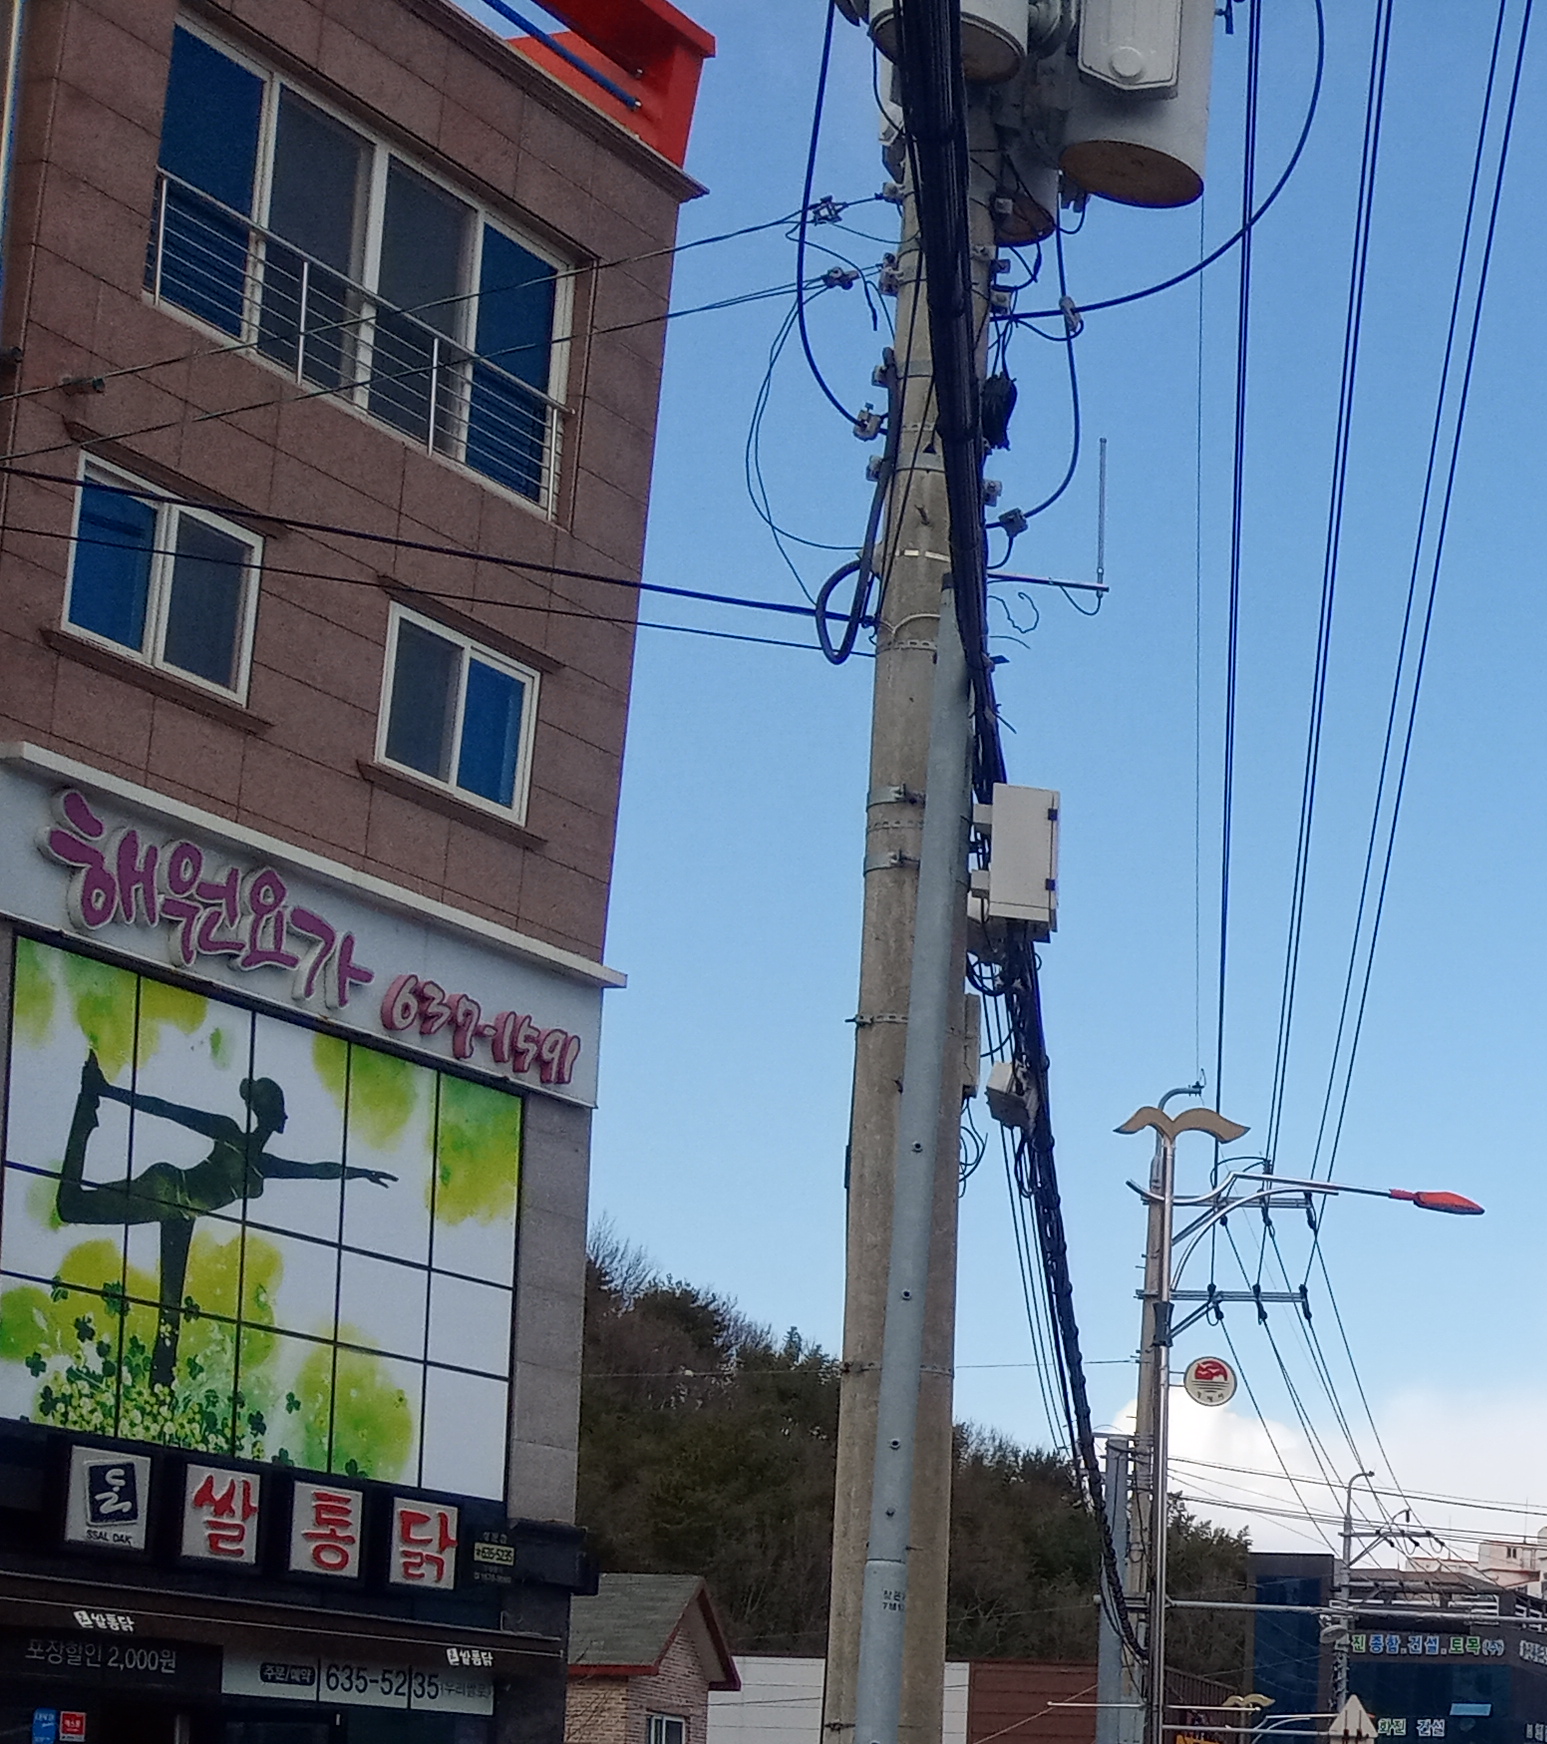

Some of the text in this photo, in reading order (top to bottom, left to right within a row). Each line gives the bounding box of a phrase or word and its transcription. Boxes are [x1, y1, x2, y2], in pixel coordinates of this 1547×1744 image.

[86, 1531, 133, 1546] SSAL DAK
[107, 1646, 176, 1673] 2,000원
[325, 1664, 439, 1699] 635-5235
